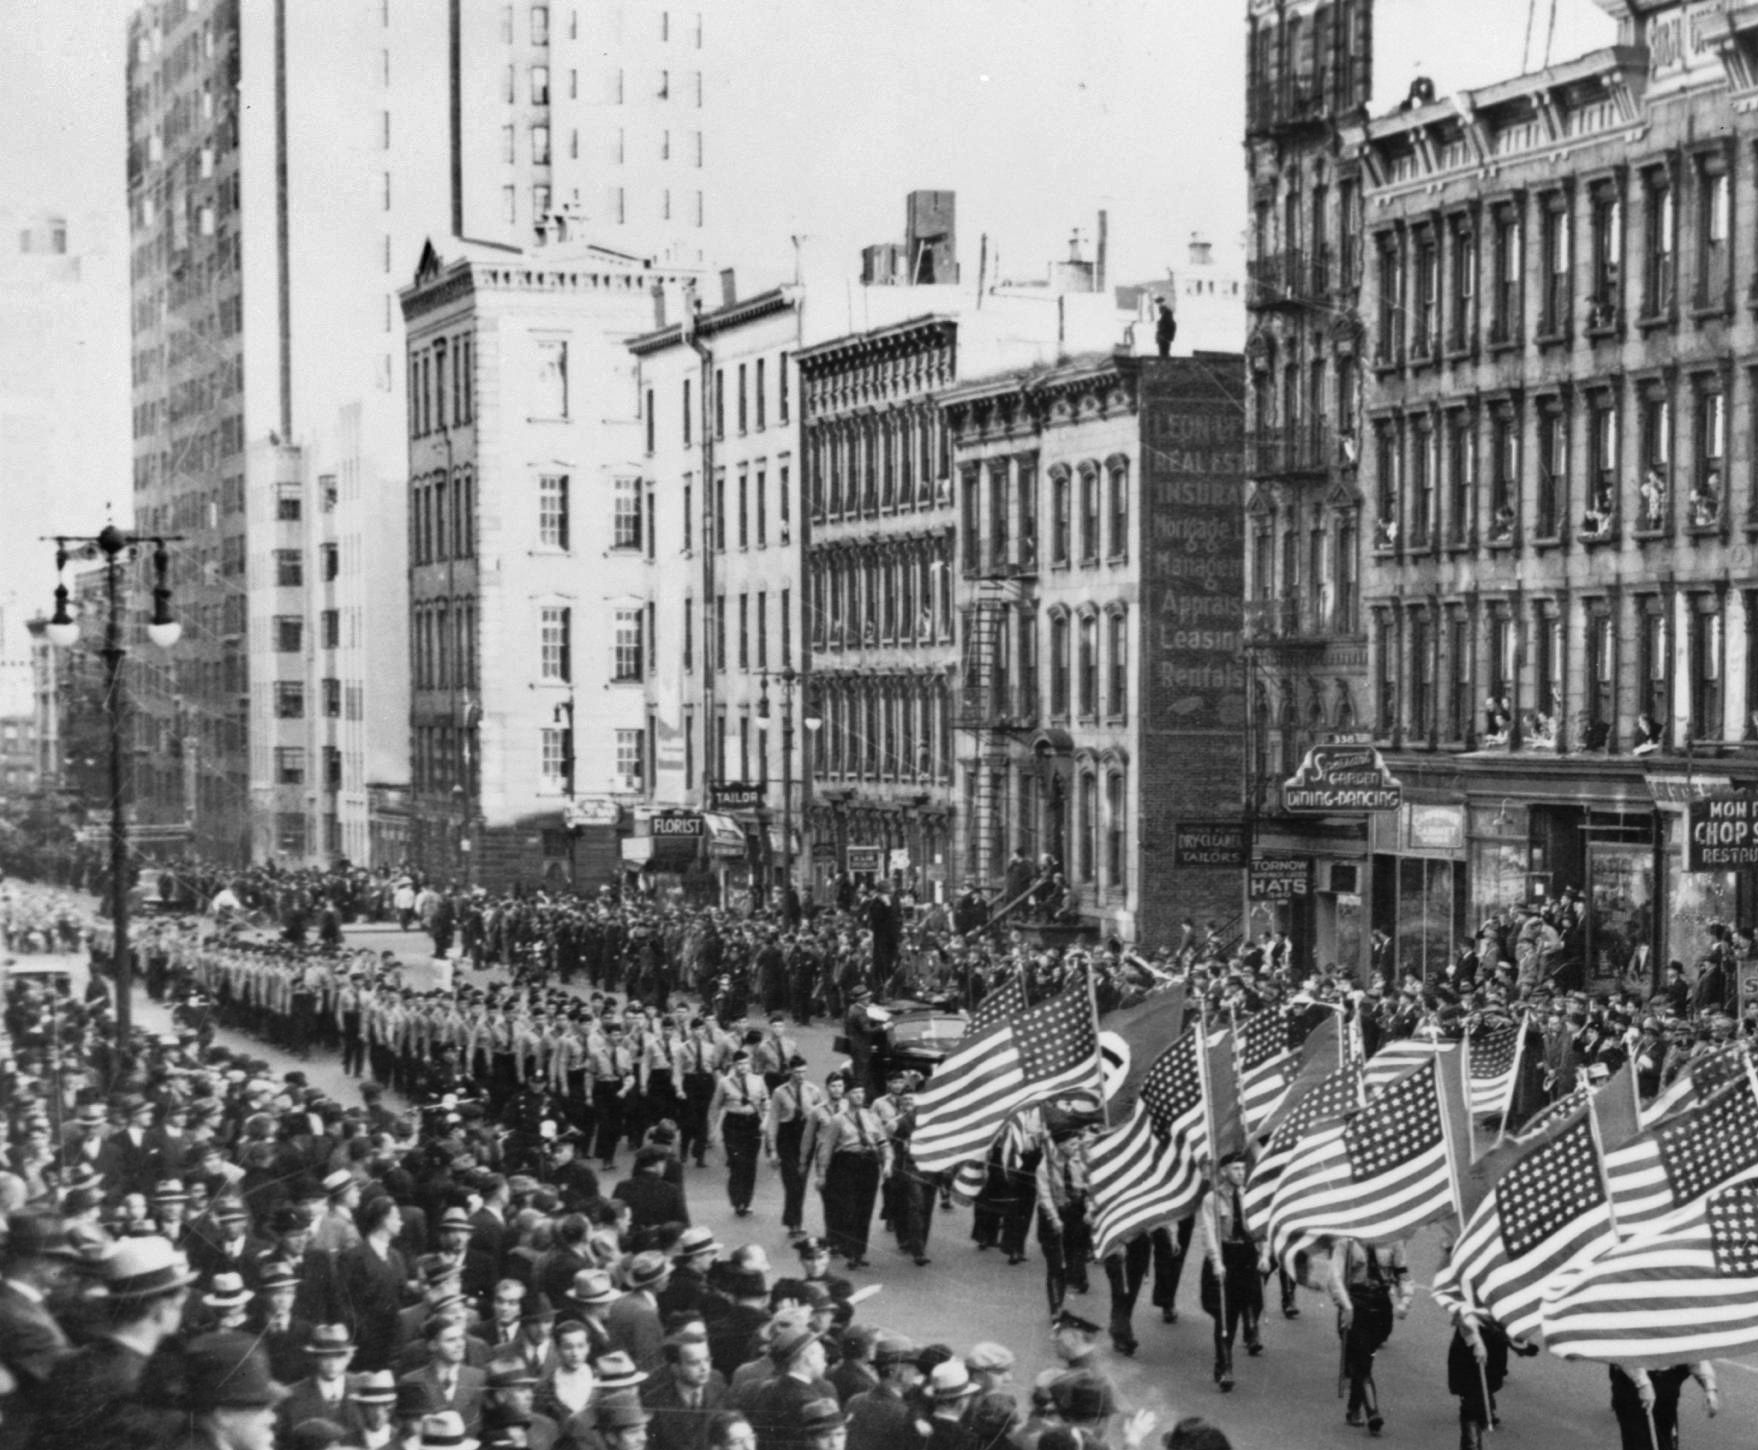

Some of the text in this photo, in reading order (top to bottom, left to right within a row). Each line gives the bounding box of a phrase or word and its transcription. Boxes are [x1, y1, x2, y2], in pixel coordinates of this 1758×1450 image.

[716, 792, 758, 803] TAILOR
[653, 819, 701, 834] FLORIST
[1695, 820, 1749, 845] CHOP
[1183, 851, 1241, 864] TAILORS
[1250, 879, 1307, 896] HATS
